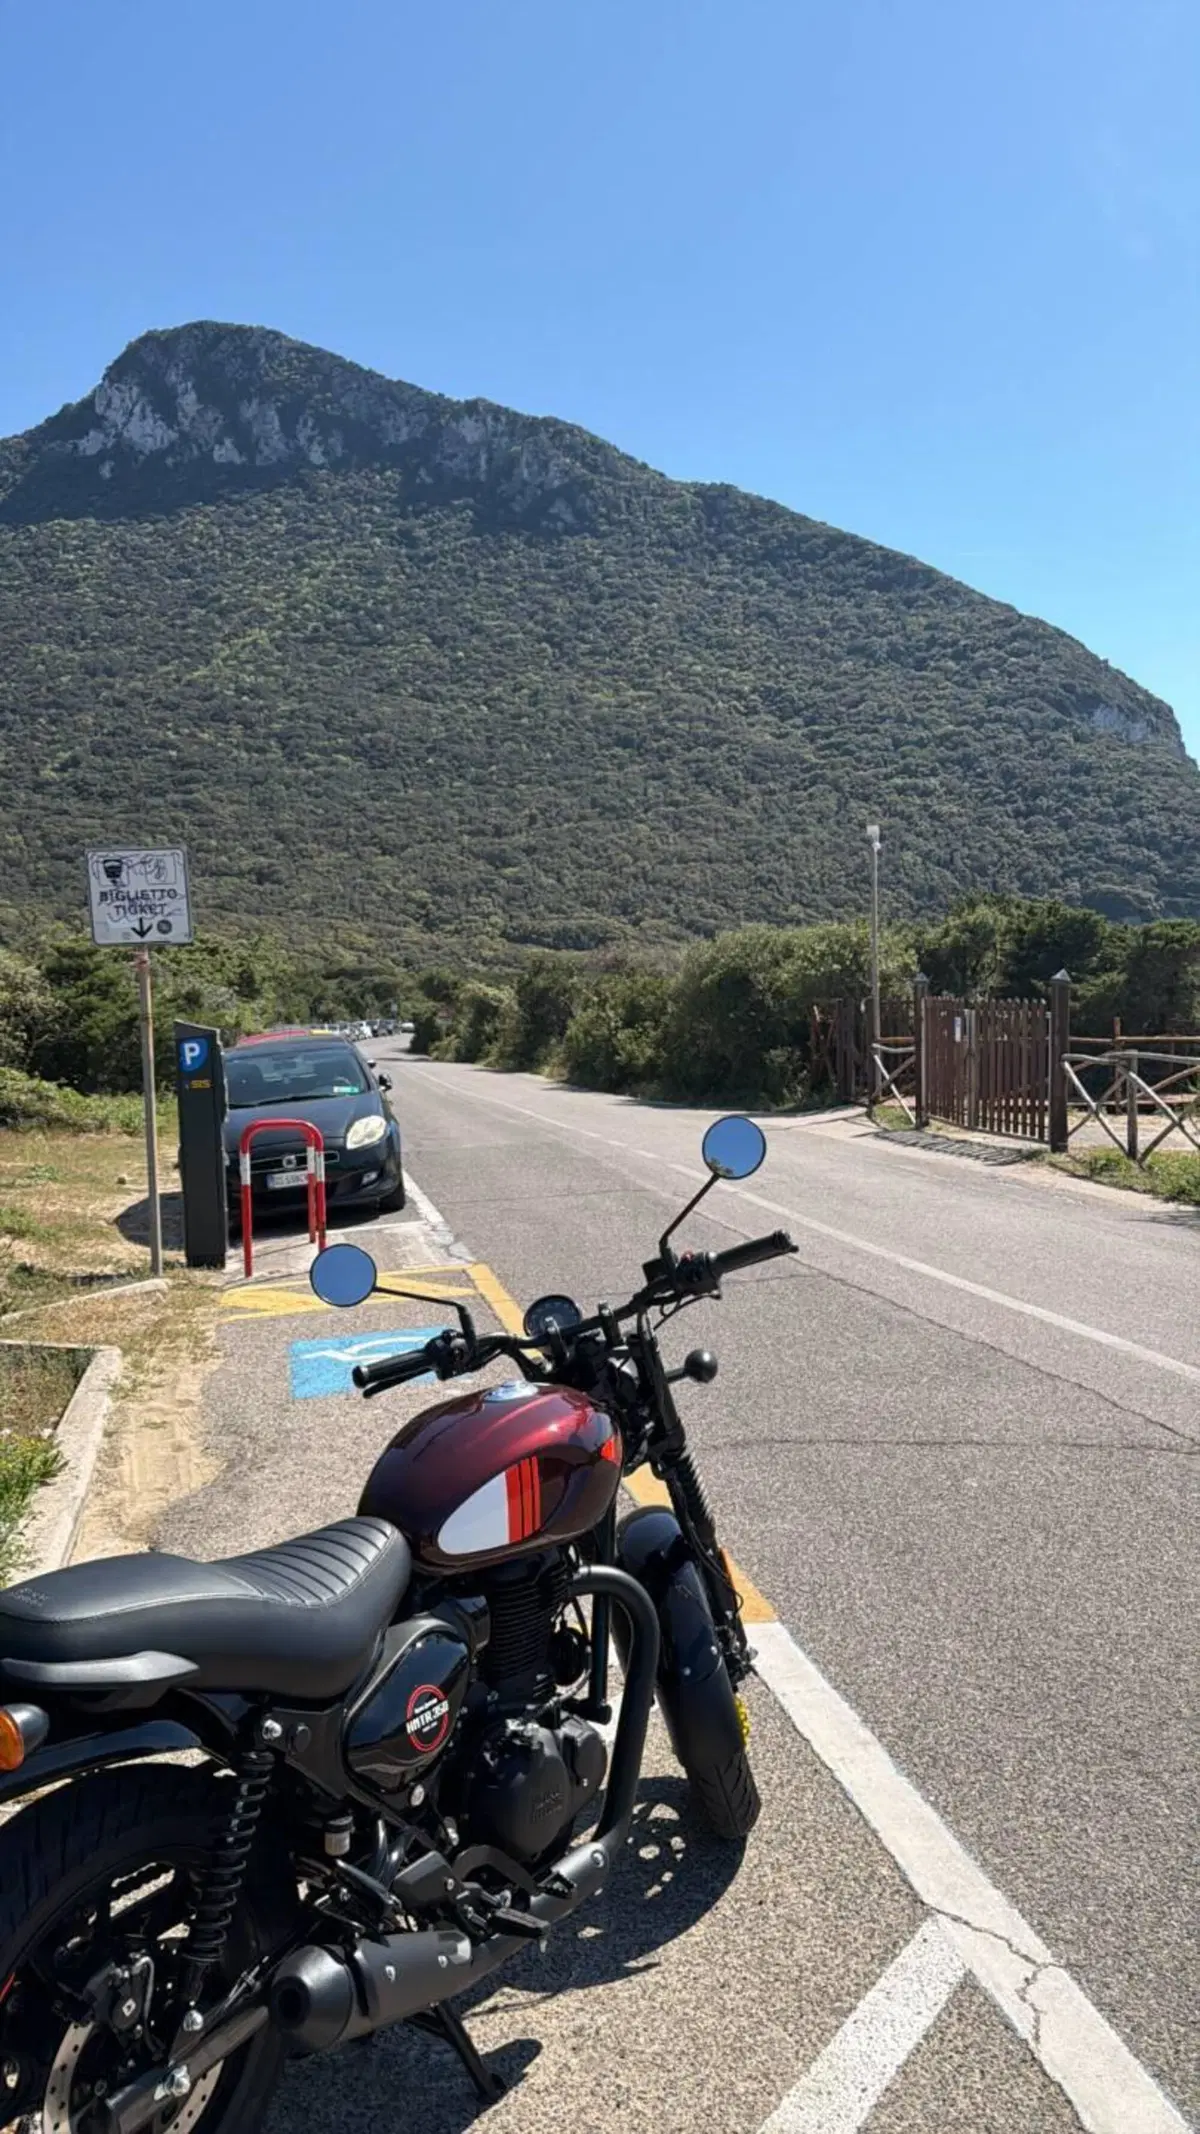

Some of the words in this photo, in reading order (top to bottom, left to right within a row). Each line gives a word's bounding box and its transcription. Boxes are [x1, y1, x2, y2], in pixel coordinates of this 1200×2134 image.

[99, 888, 178, 902] BIGLIETTO
[113, 903, 168, 916] TICKET
[183, 1042, 200, 1065] P
